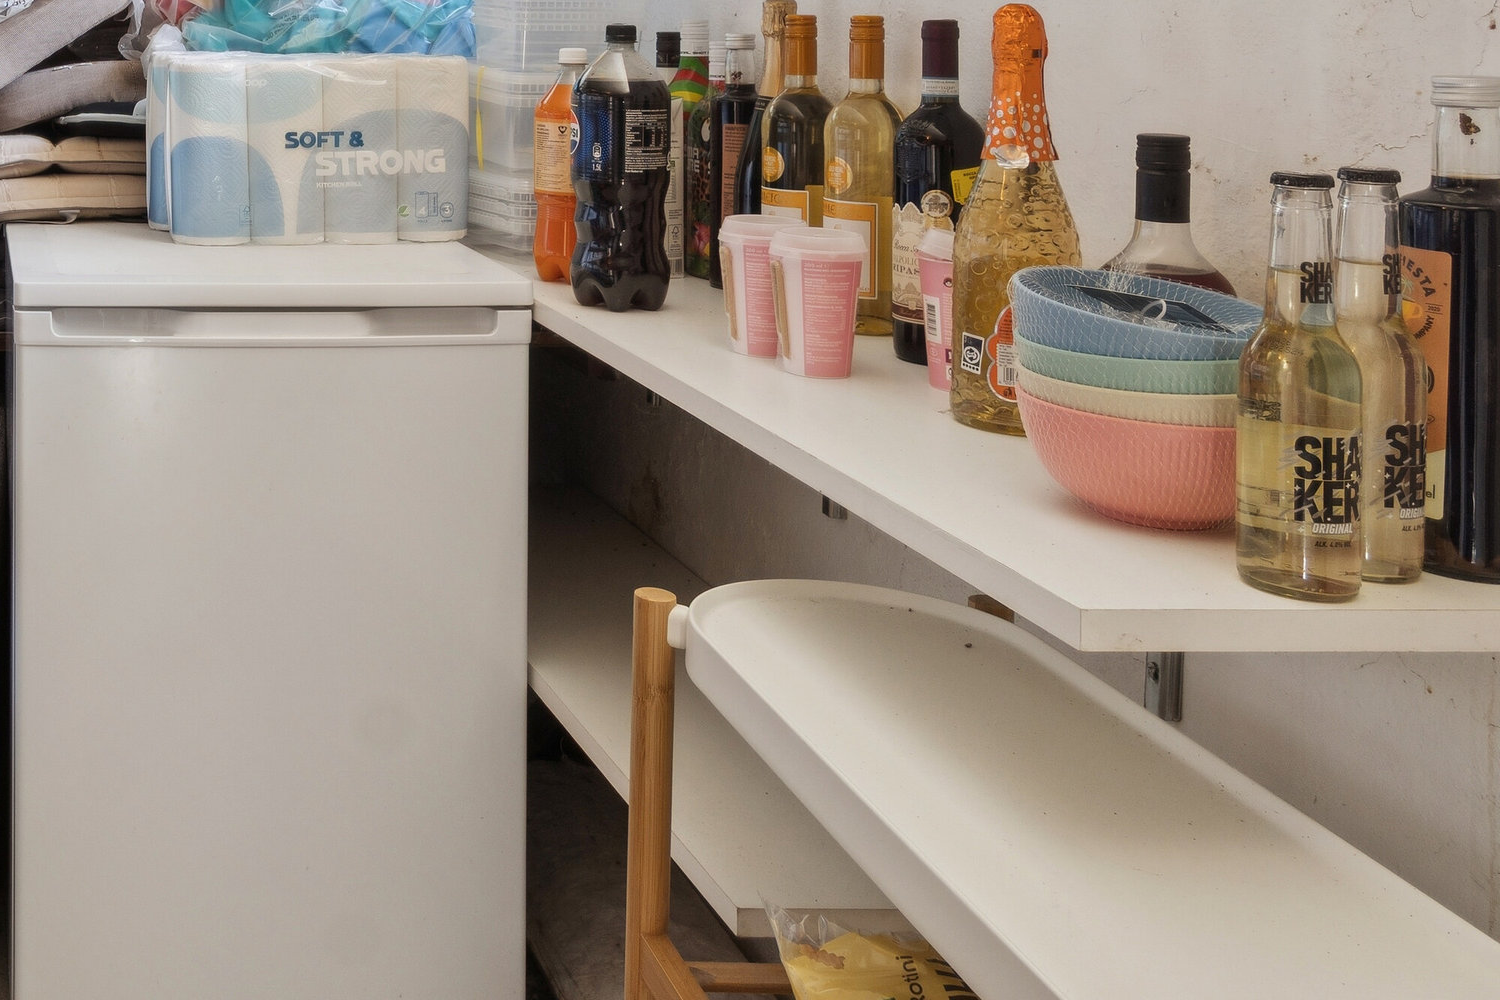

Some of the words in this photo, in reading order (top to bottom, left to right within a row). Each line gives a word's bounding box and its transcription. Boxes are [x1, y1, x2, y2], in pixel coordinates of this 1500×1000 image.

[285, 131, 344, 149] SOFT
[349, 131, 364, 148] &
[315, 148, 446, 177] STRONG
[316, 181, 344, 189] KITCHEN
[1300, 261, 1333, 283] SHA
[1382, 253, 1402, 274] SH
[1300, 281, 1334, 304] KER
[1382, 274, 1402, 295] KE
[1415, 314, 1435, 340] MPANY
[1294, 435, 1361, 481] SHA
[1384, 466, 1426, 508] KE
[1294, 478, 1361, 524] KER
[1312, 522, 1353, 536] ORIGINAL
